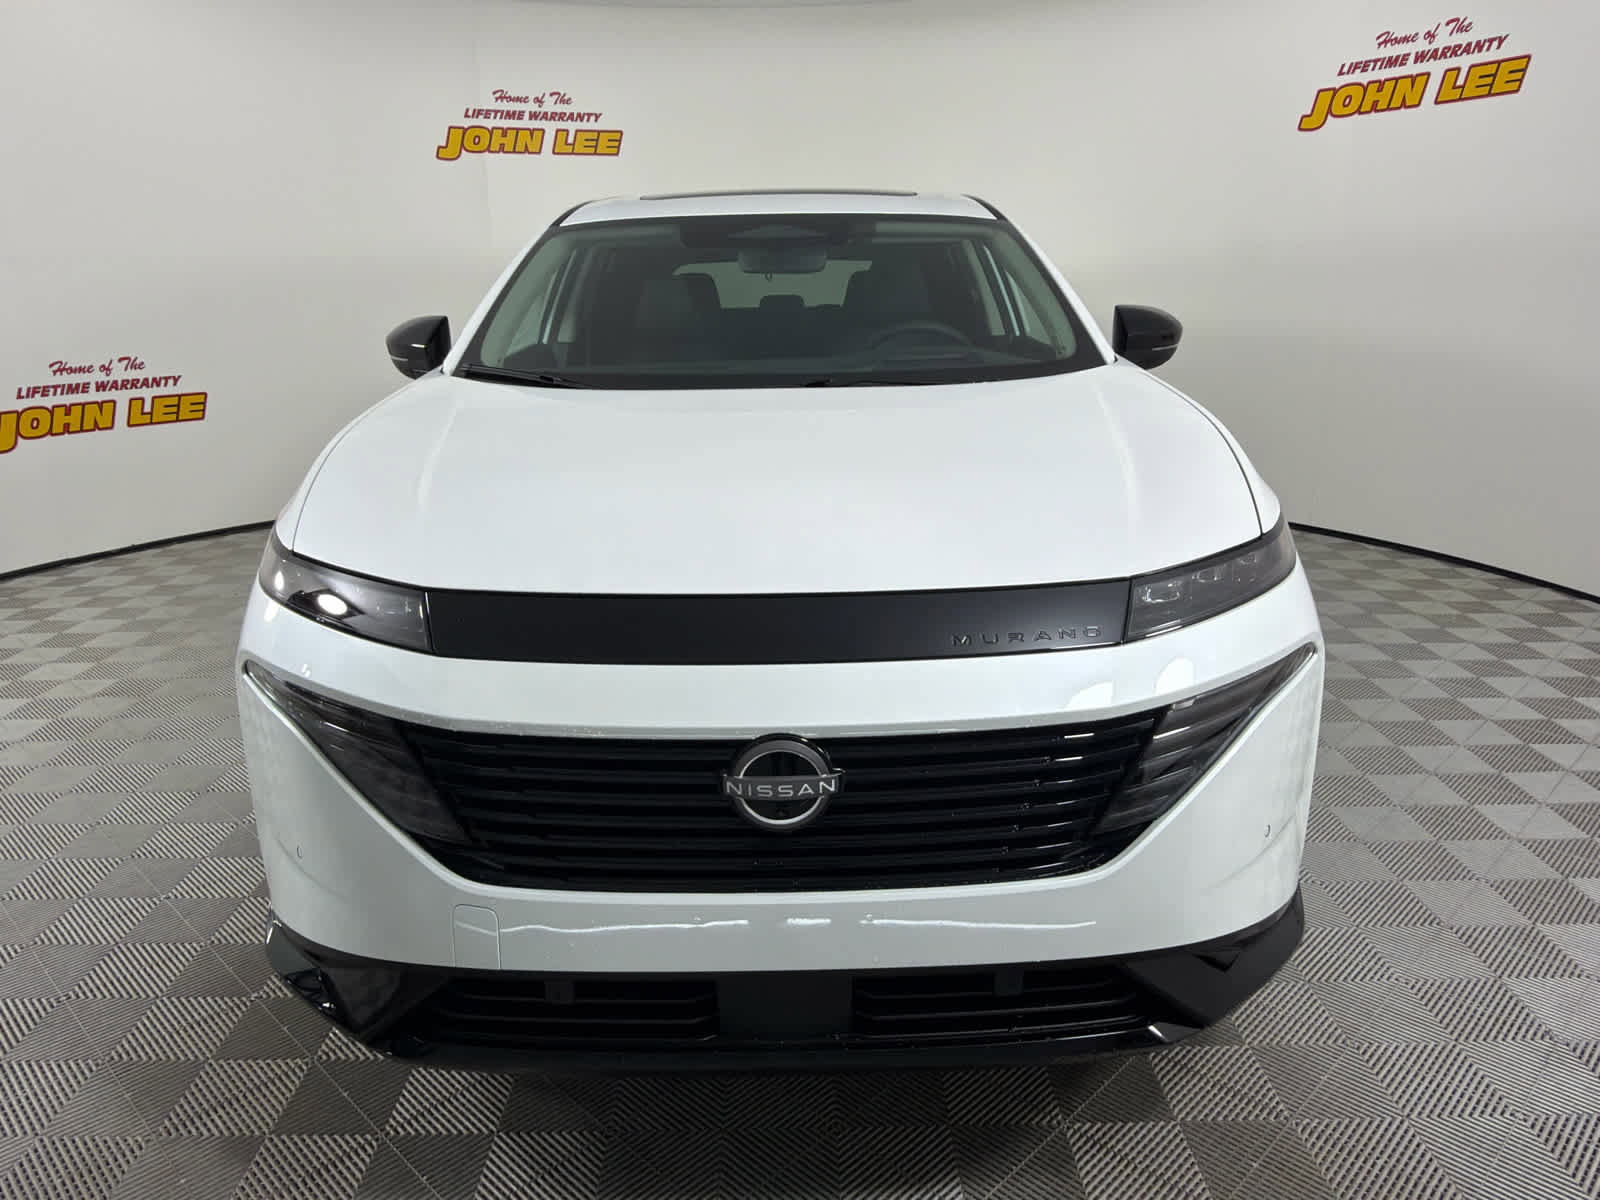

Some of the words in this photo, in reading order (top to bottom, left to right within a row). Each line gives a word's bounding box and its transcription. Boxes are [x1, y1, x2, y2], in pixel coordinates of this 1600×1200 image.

[1375, 31, 1419, 49] Home
[1423, 23, 1441, 45] of
[1445, 16, 1474, 37] The
[1337, 53, 1410, 77] LIFETIME
[1413, 33, 1510, 65] WARRANTY
[492, 89, 530, 103] Home
[533, 92, 546, 108] of
[549, 91, 573, 105] The
[1297, 71, 1431, 132] JOHN
[1434, 54, 1532, 105] LEE
[464, 107, 526, 121] LIFETIME
[528, 110, 603, 123] WARRANTY
[436, 125, 545, 161] JOHN
[552, 128, 623, 156] LEE
[49, 360, 94, 376] Home
[99, 359, 113, 377] of
[118, 356, 146, 372] The
[16, 382, 90, 400] LIFETIME
[95, 375, 182, 393] WARRANTY
[0, 399, 117, 454] JOHN
[127, 392, 208, 427] LEE
[952, 625, 1102, 647] MURANO
[726, 779, 835, 797] NISSAN
